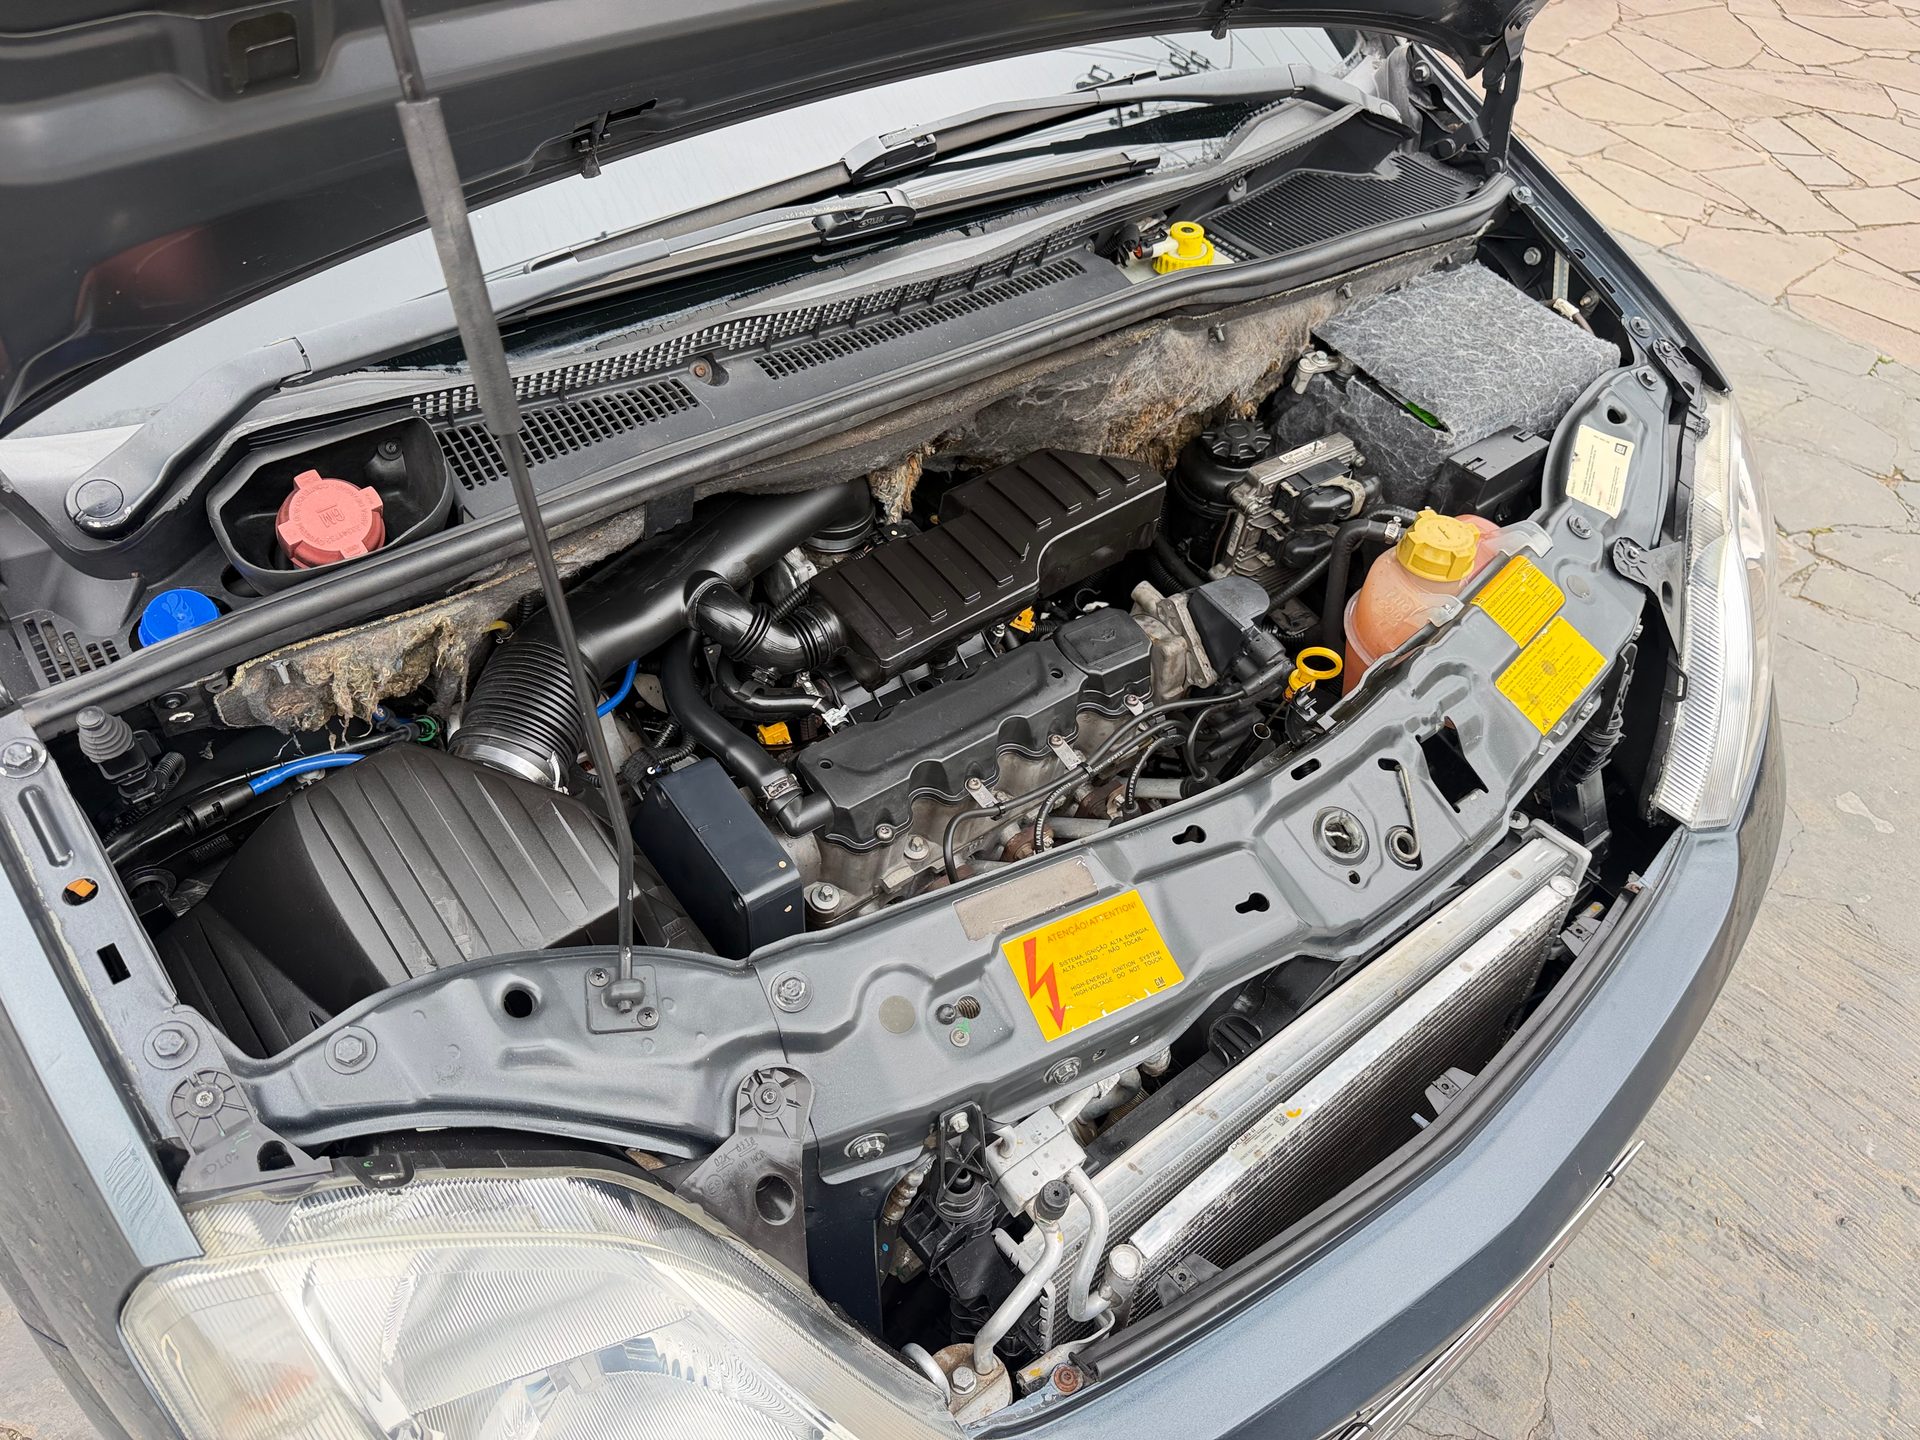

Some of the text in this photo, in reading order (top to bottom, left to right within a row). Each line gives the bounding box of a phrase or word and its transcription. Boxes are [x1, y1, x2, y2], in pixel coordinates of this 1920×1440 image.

[319, 507, 345, 528] GM
[1058, 954, 1084, 967] SISTEMA
[1084, 943, 1108, 958] IGNIÇÃO
[1110, 936, 1124, 946] ALTA
[1062, 963, 1076, 974] ALTA
[1076, 955, 1099, 969] TENSÃO
[1108, 945, 1121, 955] NÃO
[1112, 960, 1136, 975] IGNITION
[1139, 950, 1161, 962] SYSTEM
[1073, 977, 1114, 998] HIGH-VOLTAGE
[1117, 970, 1126, 979] DO
[1129, 965, 1141, 974] NOT
[1154, 976, 1166, 986] GM
